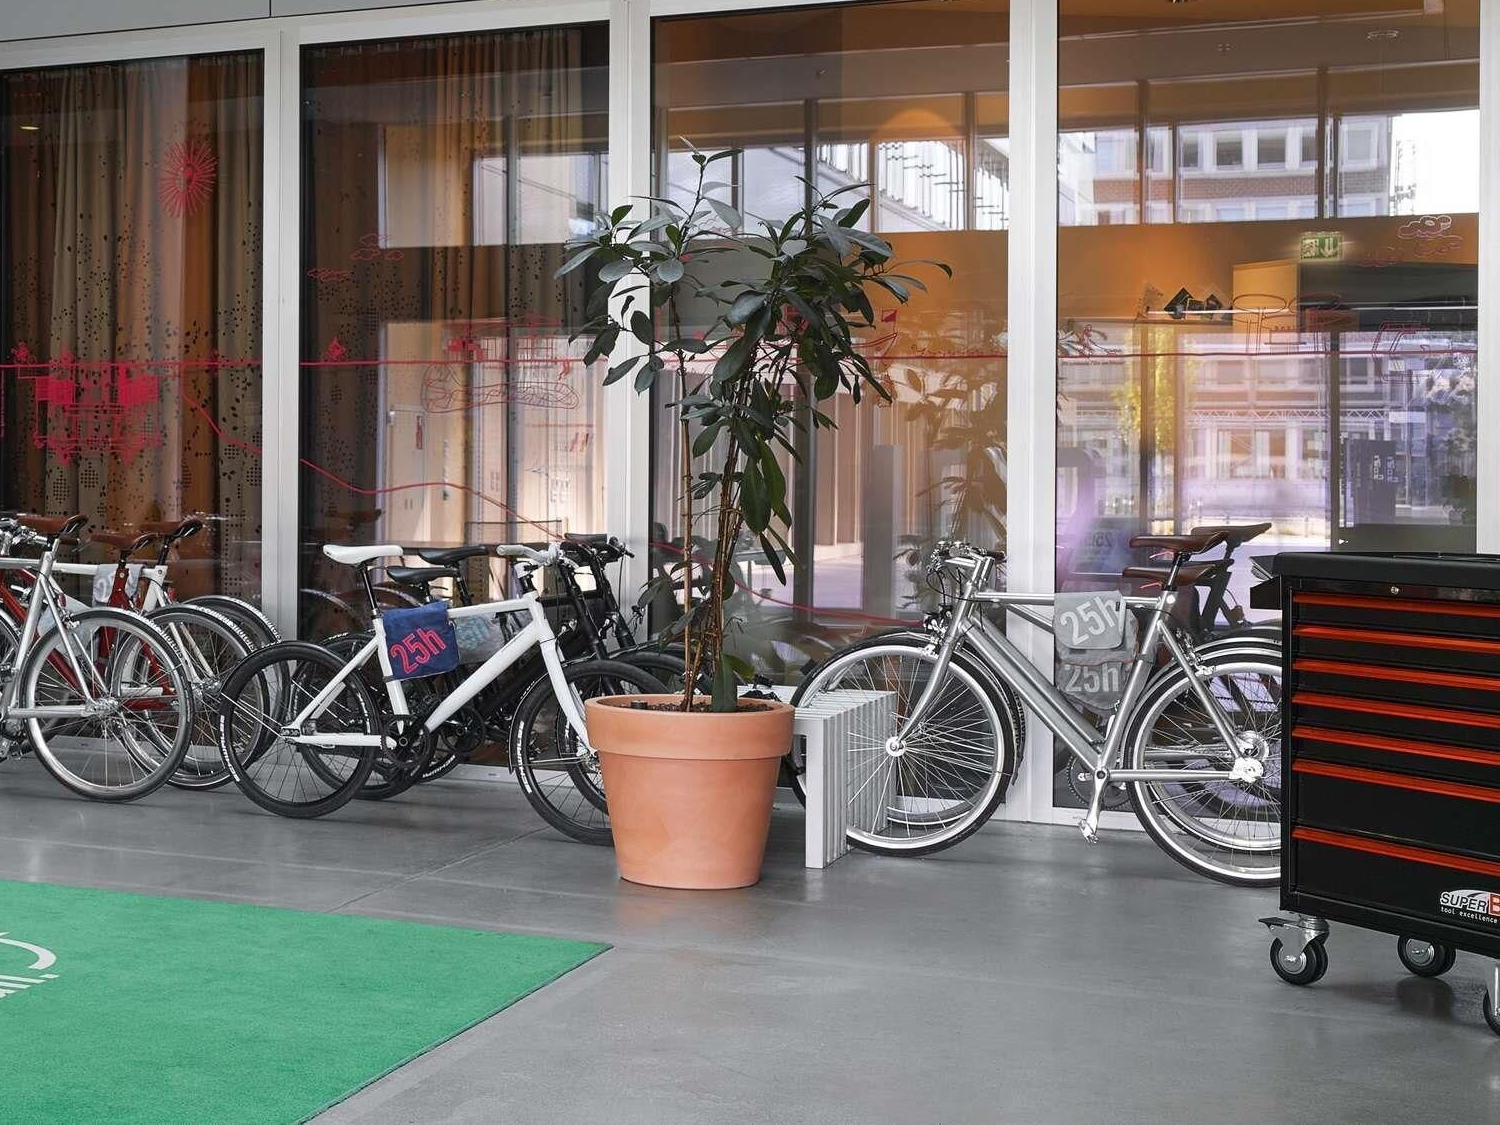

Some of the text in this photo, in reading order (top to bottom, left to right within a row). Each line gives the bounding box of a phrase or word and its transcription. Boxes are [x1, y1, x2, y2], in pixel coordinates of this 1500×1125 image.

[1060, 596, 1122, 645] 25h
[390, 628, 447, 674] 25h
[1065, 662, 1120, 693] 25h
[1440, 906, 1498, 924] tool excellence
